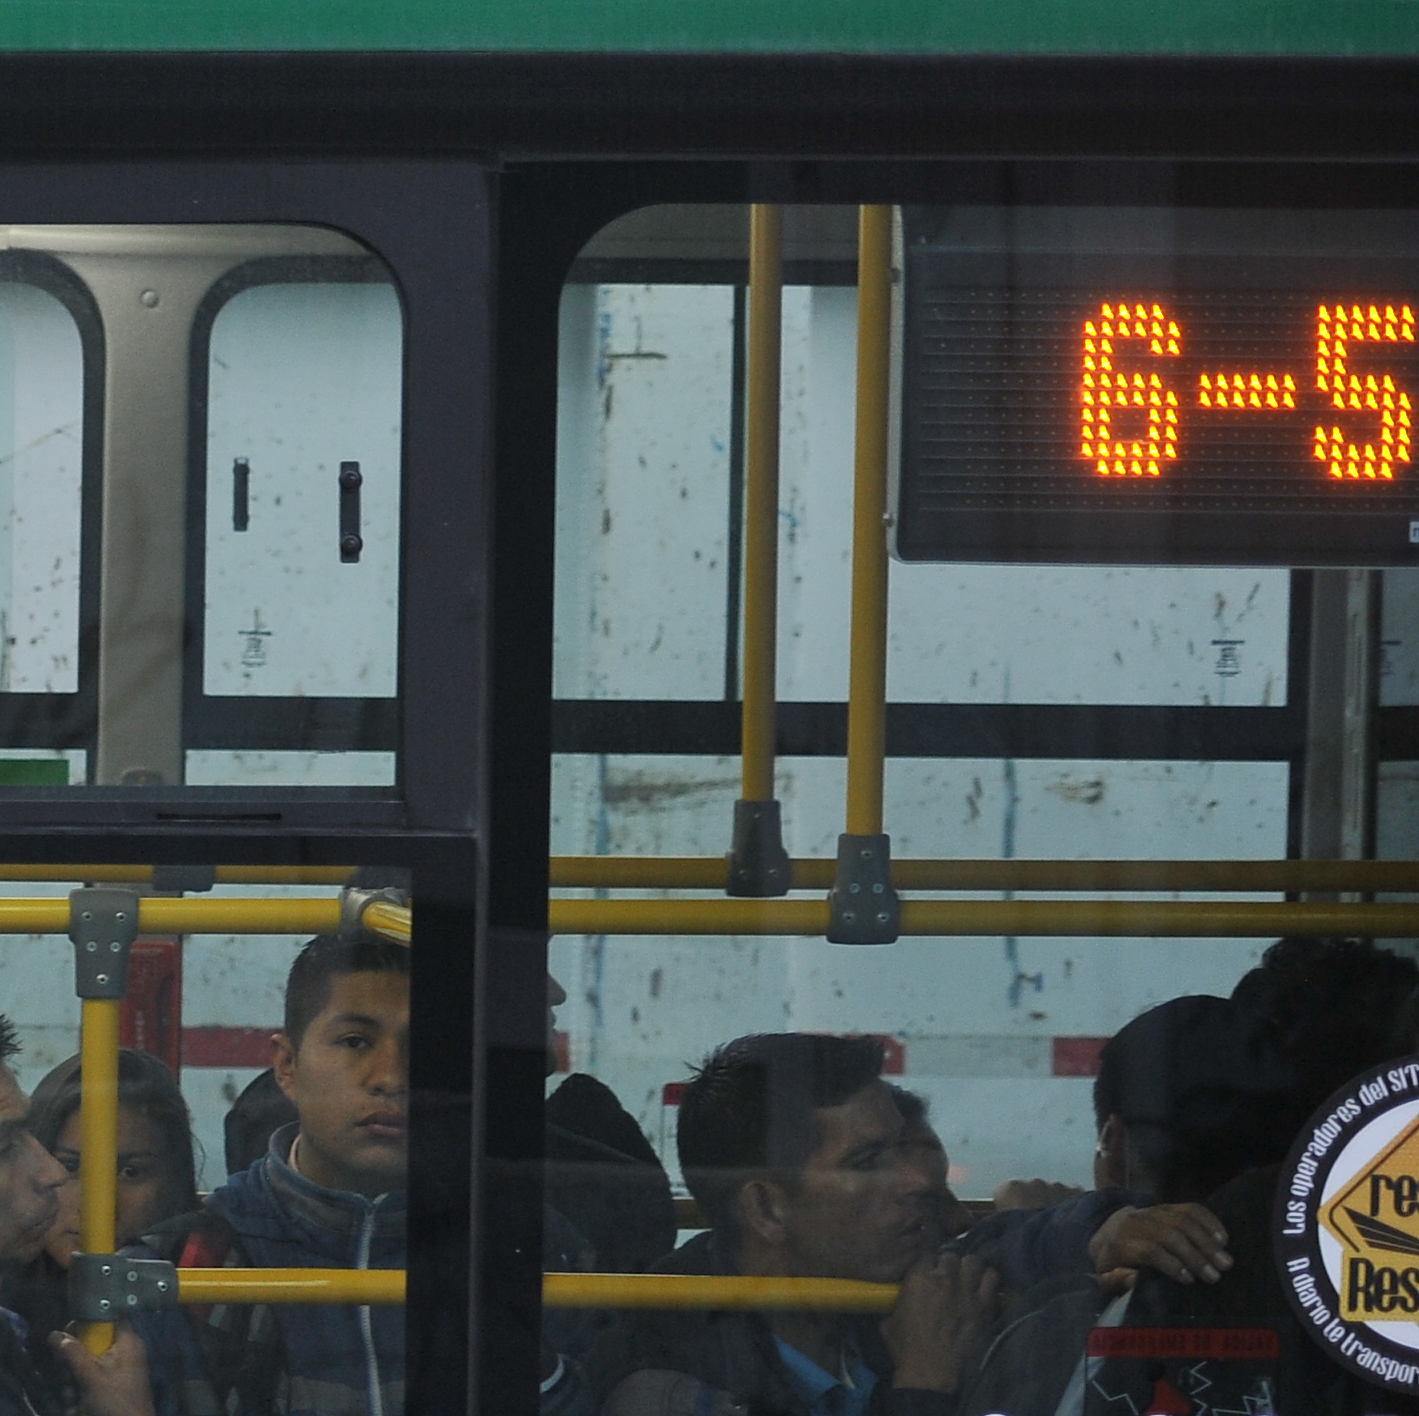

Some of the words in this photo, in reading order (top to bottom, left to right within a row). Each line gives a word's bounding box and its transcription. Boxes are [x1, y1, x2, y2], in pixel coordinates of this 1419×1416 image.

[1082, 303, 1417, 481] 6-5
[1358, 1075, 1389, 1107] del
[1290, 1098, 1362, 1197] operadores
[1282, 1200, 1307, 1235] Los
[1370, 1174, 1419, 1217] re
[1291, 1271, 1330, 1326] diario
[1322, 1317, 1346, 1343] te
